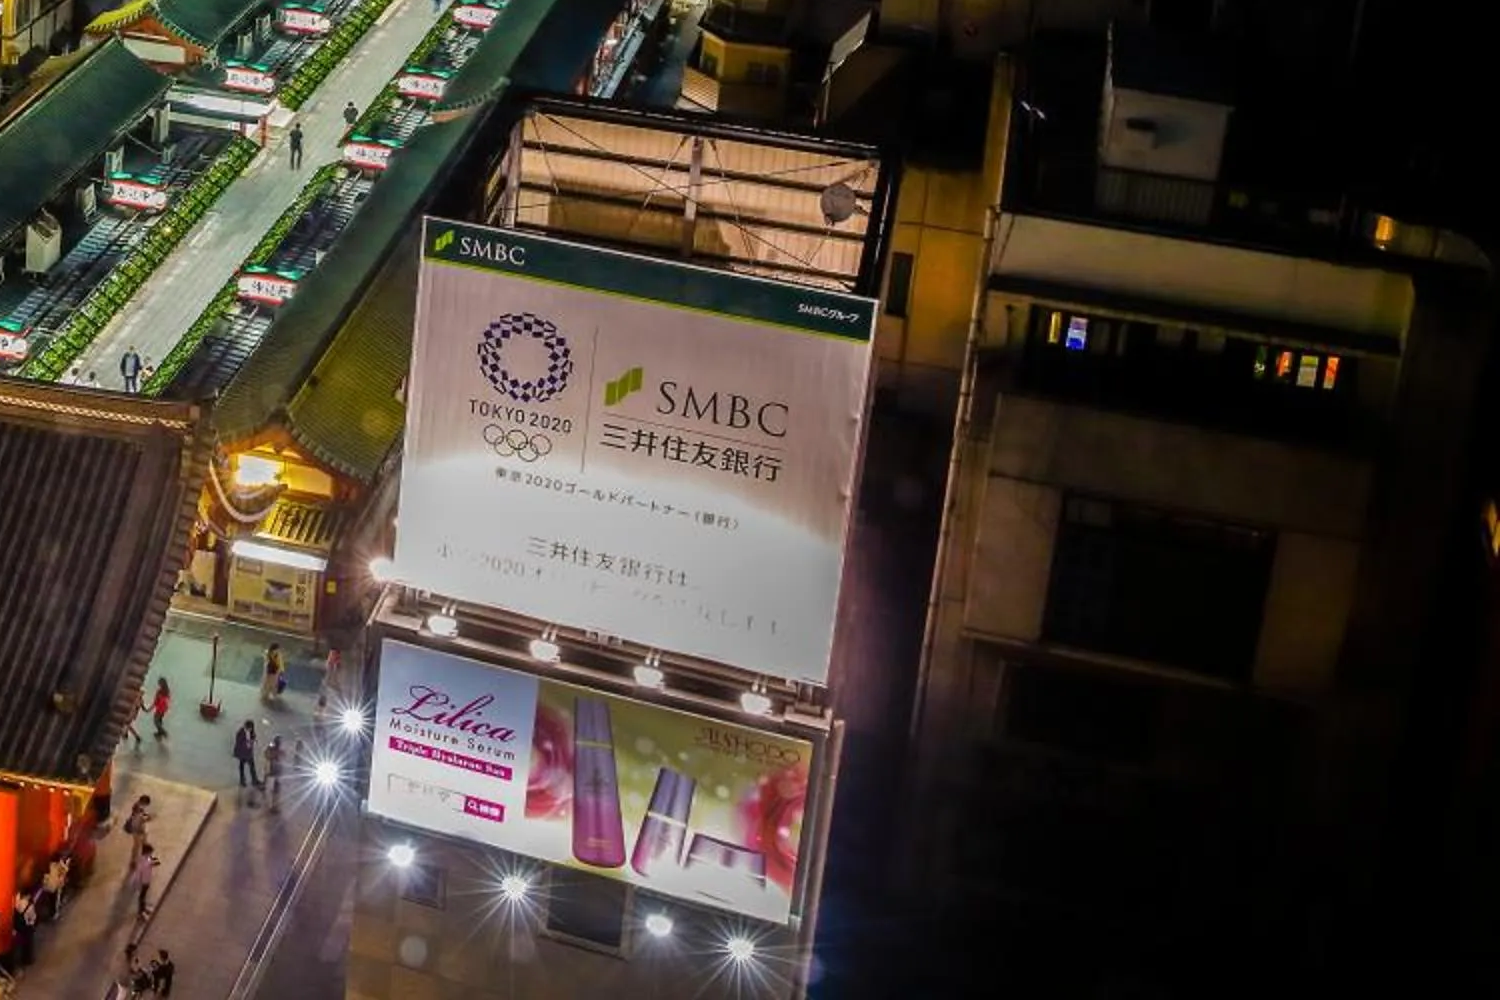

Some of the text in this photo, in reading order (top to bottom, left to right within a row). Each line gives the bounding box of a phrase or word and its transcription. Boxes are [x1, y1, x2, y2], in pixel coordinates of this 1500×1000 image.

[460, 236, 526, 266] SMBC
[469, 398, 573, 434] TOKYO 2020
[656, 381, 789, 438] SMBC
[599, 422, 784, 483] 三井住友銀行
[391, 685, 516, 743] Lilica
[389, 718, 515, 760] Moisture Serum
